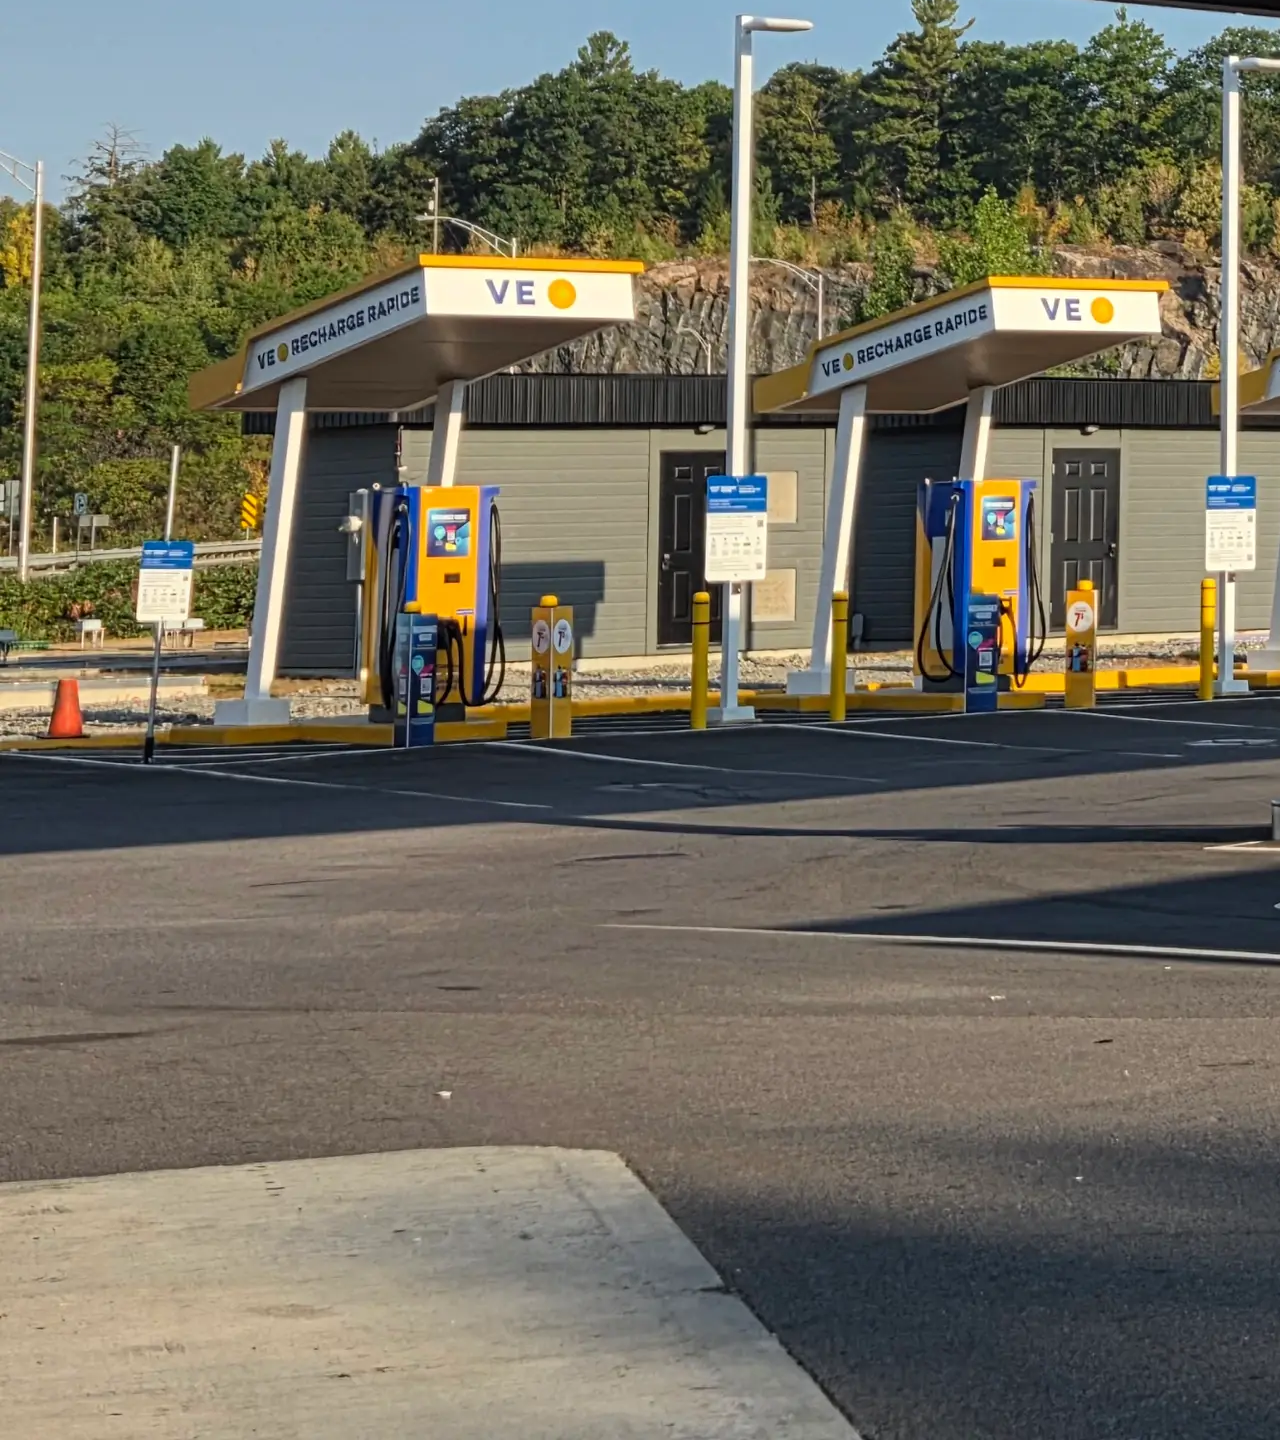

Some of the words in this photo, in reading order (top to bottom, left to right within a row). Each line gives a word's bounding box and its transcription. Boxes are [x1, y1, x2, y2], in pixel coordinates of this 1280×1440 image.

[486, 279, 535, 305] VE
[1041, 297, 1082, 321] VE
[257, 348, 276, 369] VE
[291, 311, 365, 356] RECHARGE
[367, 286, 420, 322] RAPIDE
[822, 359, 841, 377] VE
[856, 325, 933, 365] RECHARGE
[935, 304, 988, 336] RAPIDE
